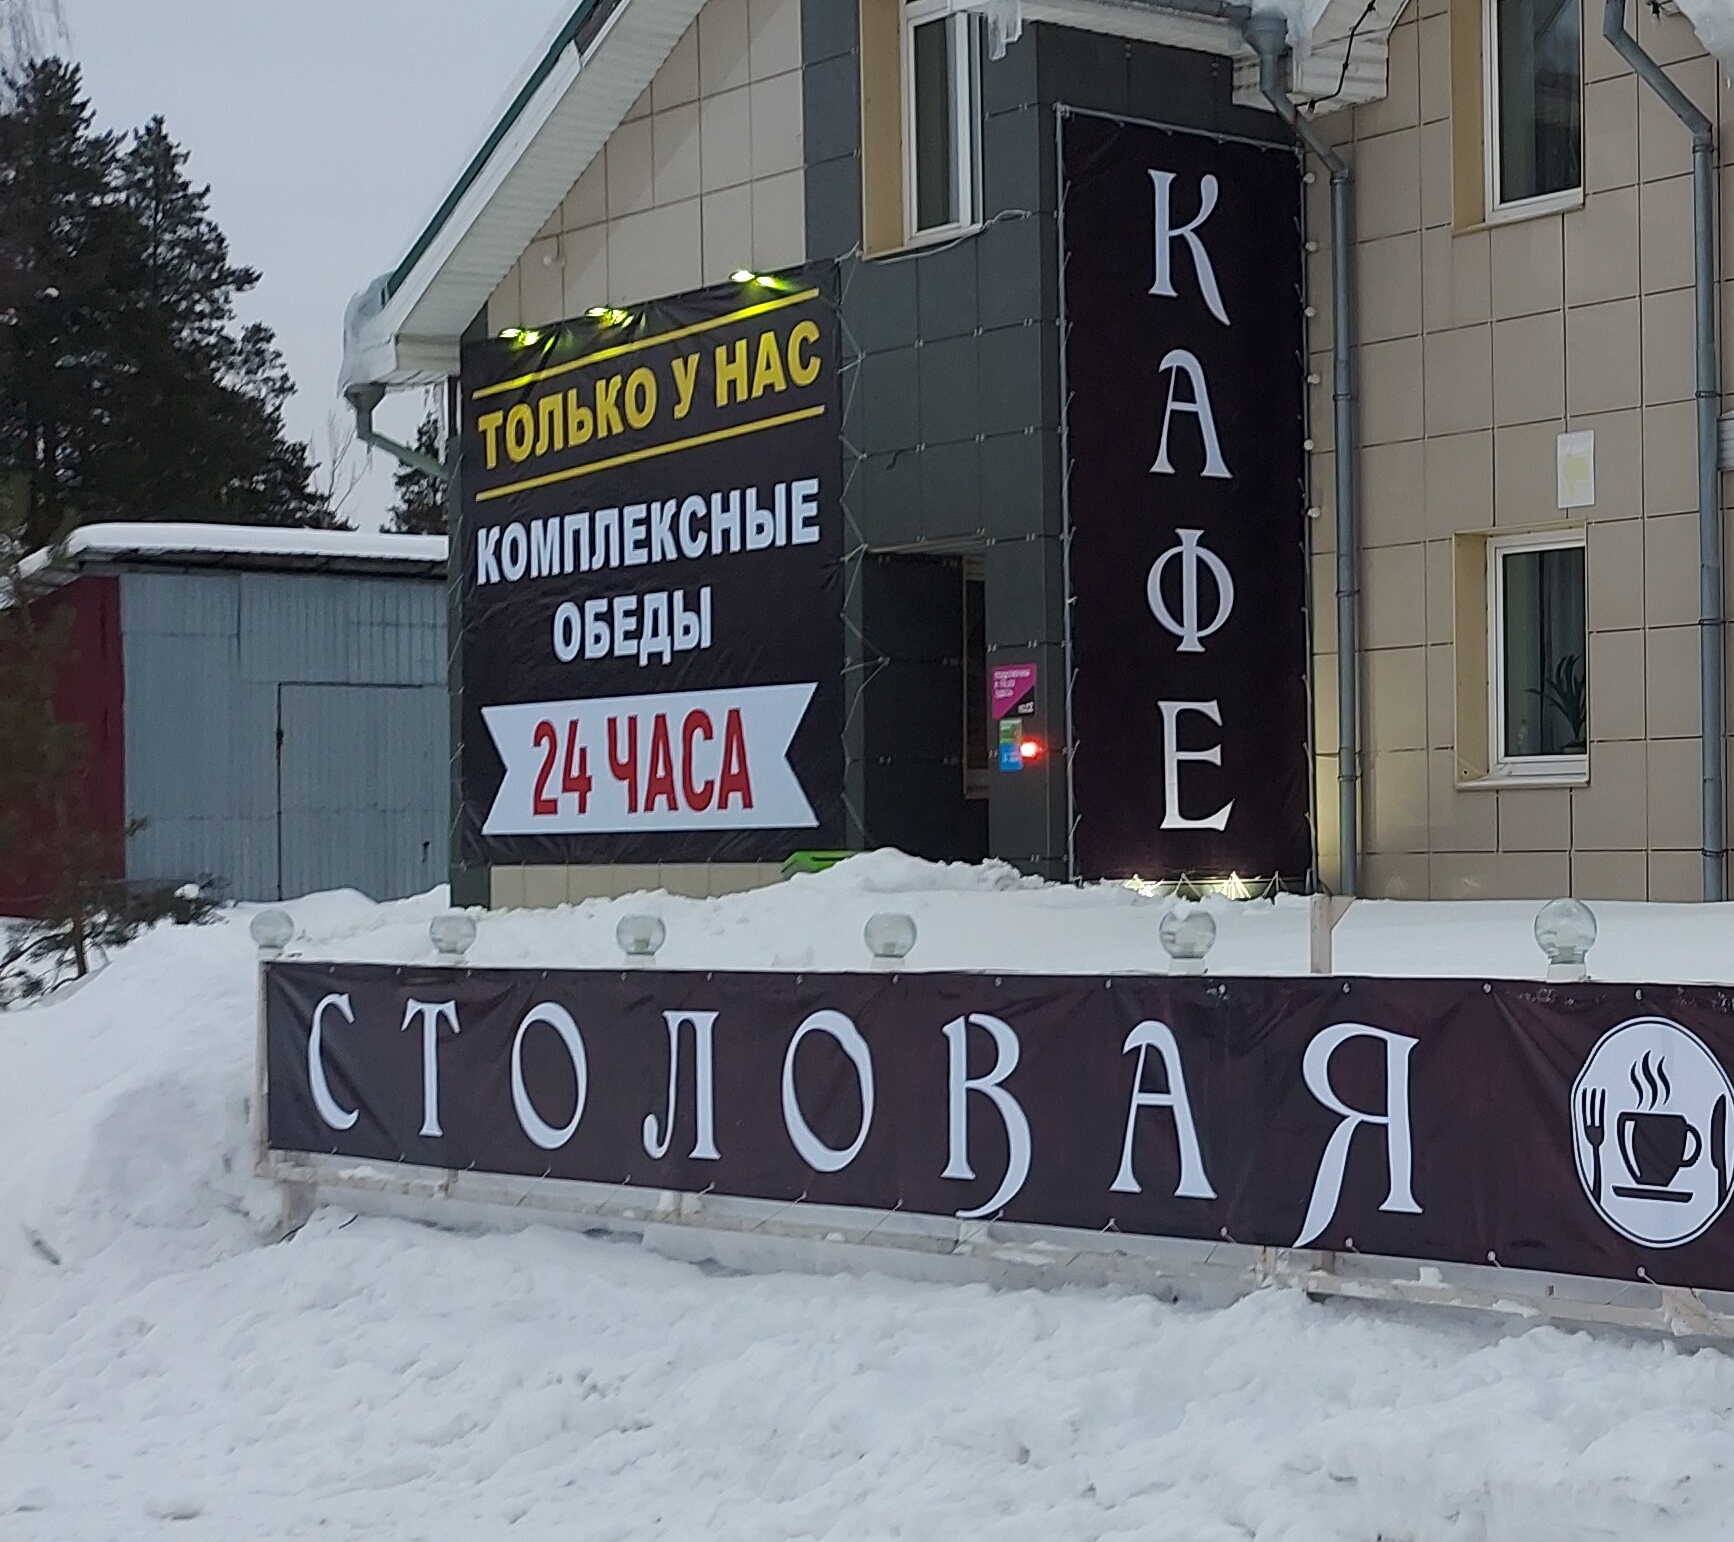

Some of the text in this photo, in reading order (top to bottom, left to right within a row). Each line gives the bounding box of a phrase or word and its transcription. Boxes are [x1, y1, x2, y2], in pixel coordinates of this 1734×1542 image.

[477, 320, 822, 470] ТОЛЬКО У НАС
[476, 477, 820, 586] КОМПЛЕКСНЫЕ
[1146, 167, 1235, 832] КАФЕ
[553, 585, 712, 667] ОБЕДЫ
[531, 707, 754, 817] 24 ЧАСА
[307, 991, 1423, 1249] СТОЛОВАЯ
